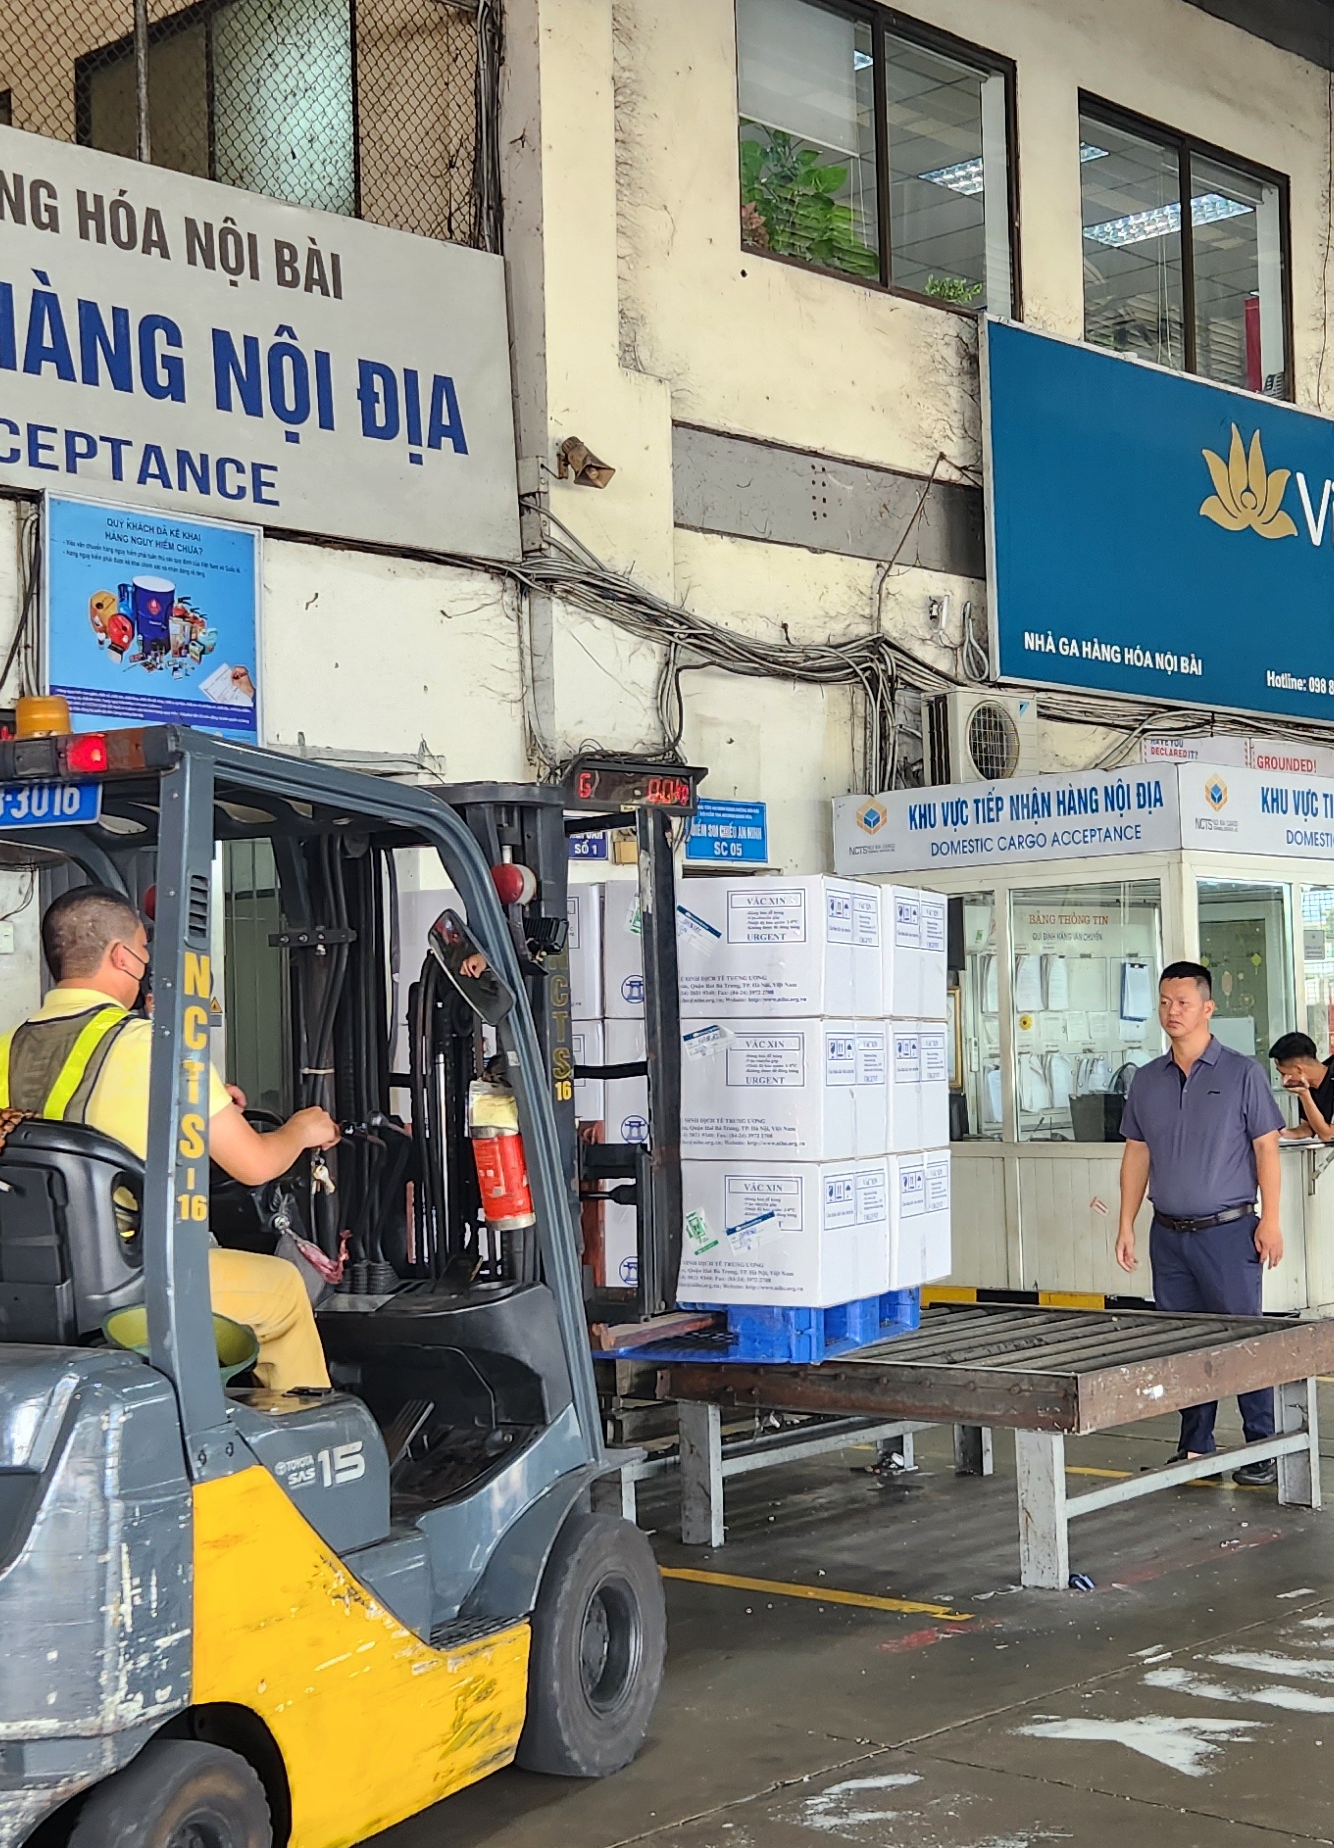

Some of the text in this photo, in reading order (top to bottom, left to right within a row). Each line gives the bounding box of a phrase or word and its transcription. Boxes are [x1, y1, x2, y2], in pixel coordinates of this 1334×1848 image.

[75, 187, 172, 261] HÓA
[184, 215, 260, 288] NỘI
[273, 238, 343, 301] BÀI
[212, 325, 335, 445] NỘI
[357, 360, 468, 465] ĐỊA
[130, 535, 154, 548] NGUY
[182, 531, 202, 542] KHAI
[1024, 630, 1203, 676] NHÀ GA HÀNG HÓA NỘI BÀI
[1266, 670, 1307, 692] Hotline:
[1308, 676, 1327, 694] 098
[1150, 747, 1187, 759] DECLARED
[1257, 755, 1317, 773] GROUNDED!
[909, 778, 1163, 833] KHU VỰC TIẾP NHẬN HÀNG NỘI ĐỊA
[1260, 786, 1287, 815] KHU
[1292, 788, 1319, 822] VỰC
[574, 840, 597, 855] SỐ 1
[714, 841, 743, 856] SC 05
[931, 824, 1142, 857] DOMESTIC CARGO ACCEPTANCE
[769, 897, 786, 906] XIN
[1093, 915, 1109, 925] TIN
[747, 932, 786, 942] URGENT
[746, 1076, 785, 1085] URGENT
[554, 1080, 573, 1102] 16
[766, 1184, 783, 1192] XIN
[177, 1193, 208, 1223] 16
[286, 1440, 366, 1488] TOYOTA 15
[287, 1467, 316, 1486] SAS
